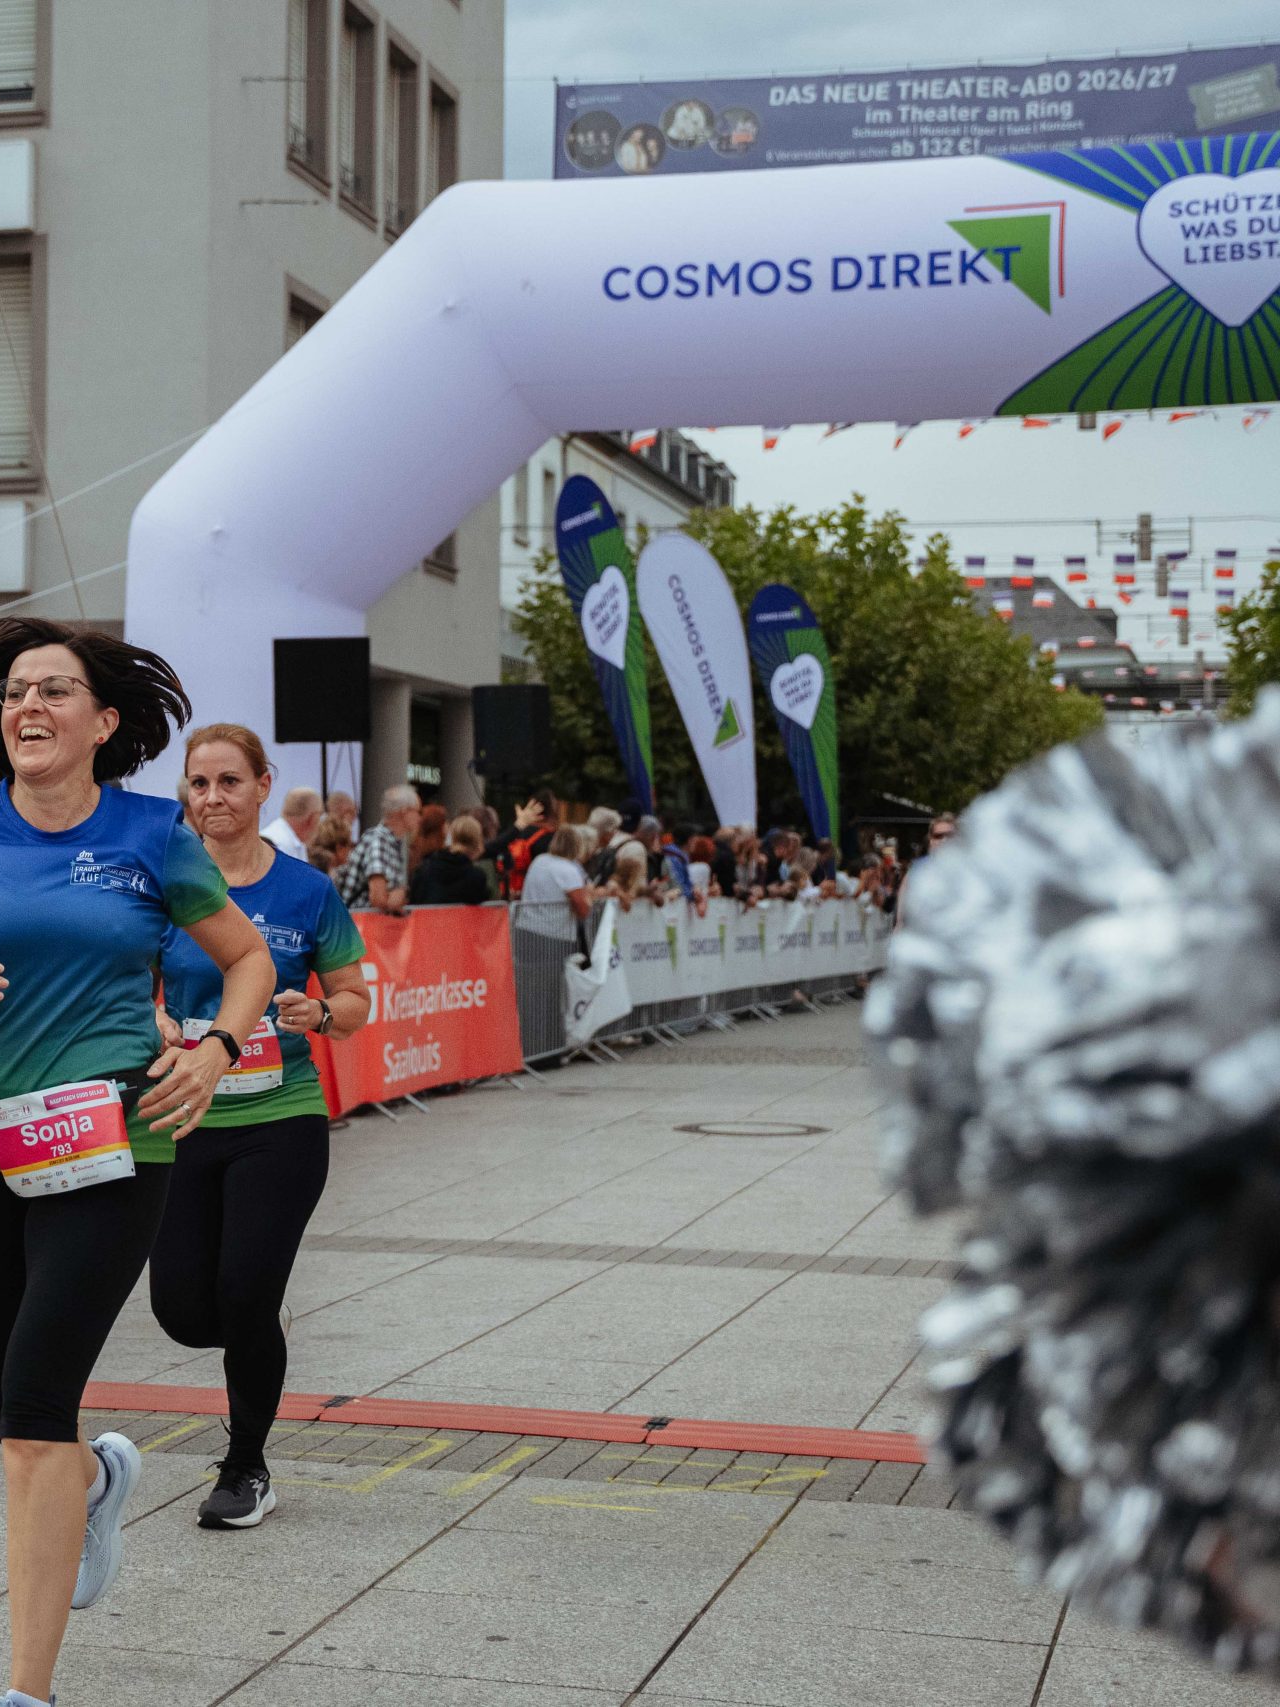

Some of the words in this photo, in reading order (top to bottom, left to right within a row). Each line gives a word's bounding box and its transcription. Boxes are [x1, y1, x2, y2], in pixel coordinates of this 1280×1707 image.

[769, 83, 817, 106] DAS
[822, 80, 892, 104] NEUE
[896, 70, 1071, 100] THEATER-ABO
[1077, 64, 1178, 92] 2026/27
[865, 106, 893, 124] im
[897, 103, 982, 124] Theater
[985, 106, 1019, 122] am
[1025, 98, 1074, 120] Ring
[891, 139, 914, 158] ab
[919, 137, 954, 157] 132
[1168, 191, 1280, 218] SCHÜTZ
[1180, 219, 1238, 240] WAS
[1247, 216, 1280, 236] DU
[602, 257, 814, 301] COSMOS
[831, 245, 1022, 293] DIREKT
[668, 574, 705, 658] COSMOS
[79, 850, 94, 859] dm
[73, 872, 100, 883] LAUF
[75, 865, 102, 873] FRAUEN
[20, 1113, 94, 1146] Sonja
[50, 1143, 73, 1157] 793
